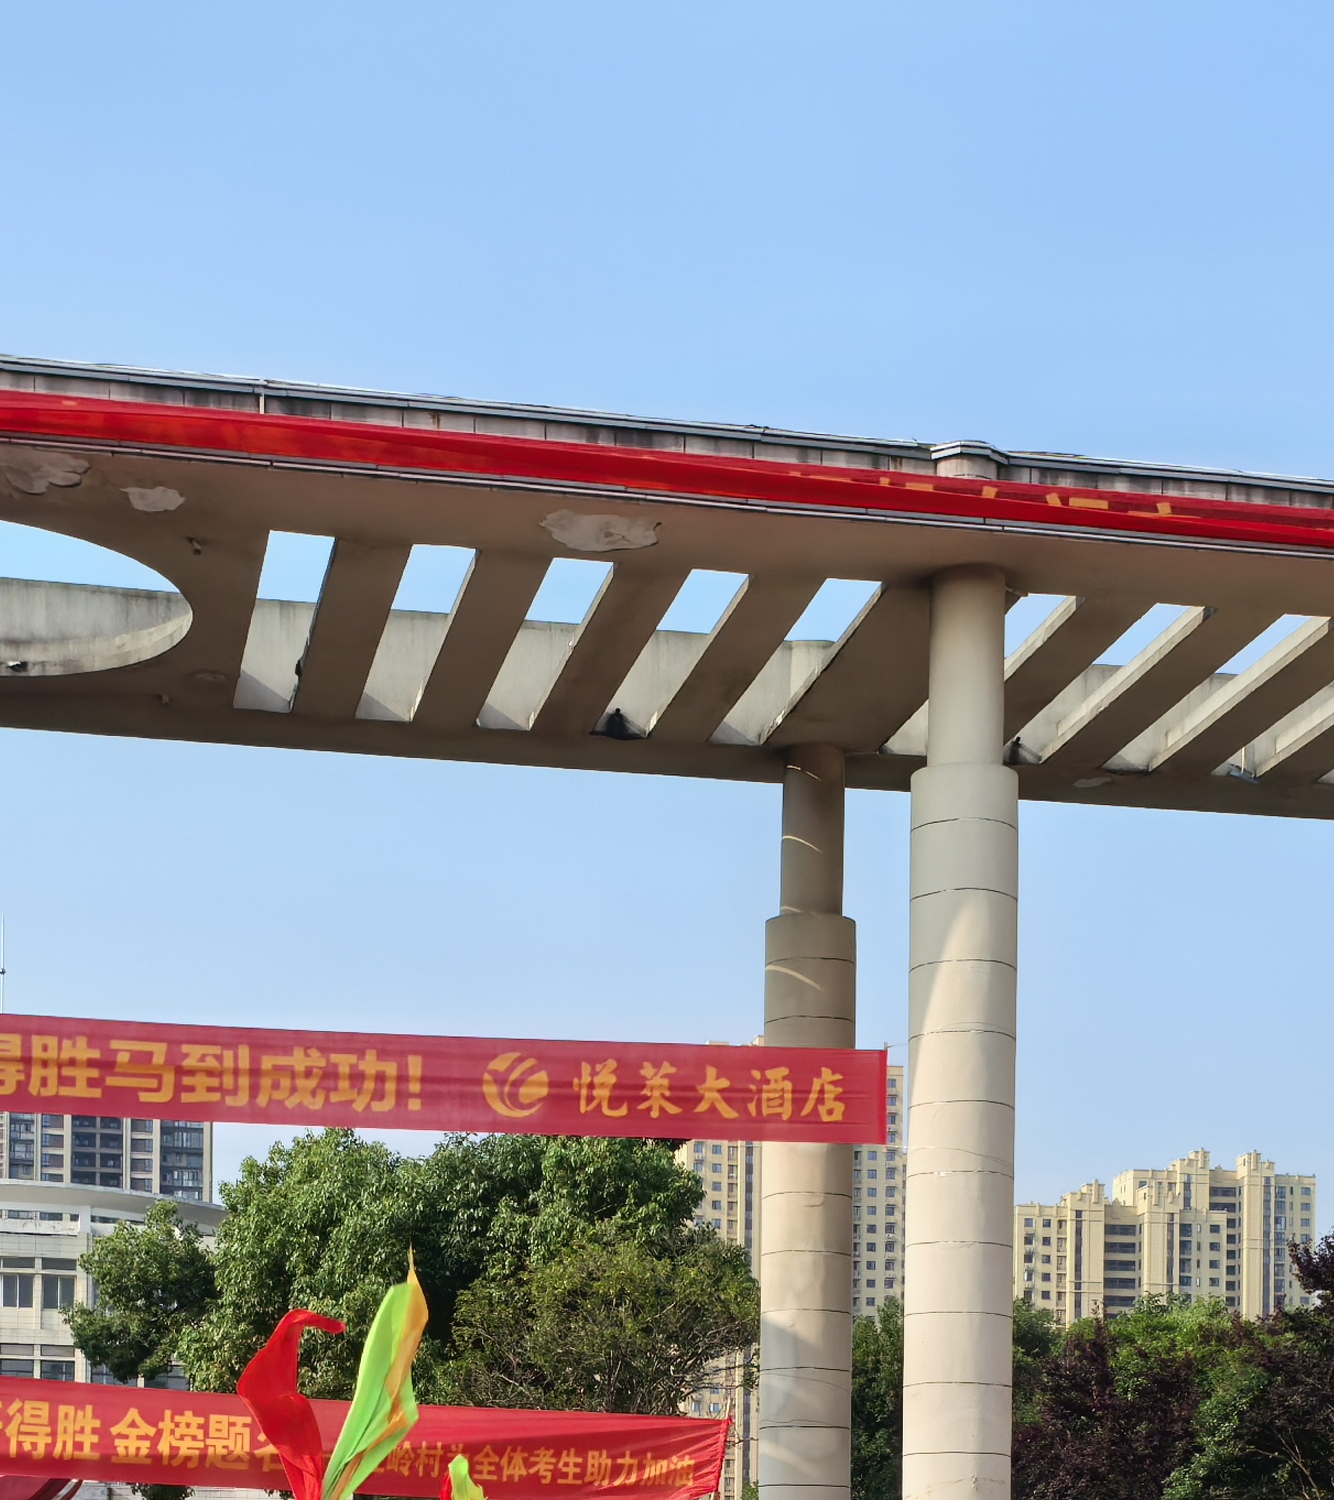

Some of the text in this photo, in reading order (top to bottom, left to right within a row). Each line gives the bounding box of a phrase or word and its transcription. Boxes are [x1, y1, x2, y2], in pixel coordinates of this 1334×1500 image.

[573, 1062, 845, 1123] 悦莱大酒店
[371, 1440, 696, 1488] 岭村全体考生助力加油
